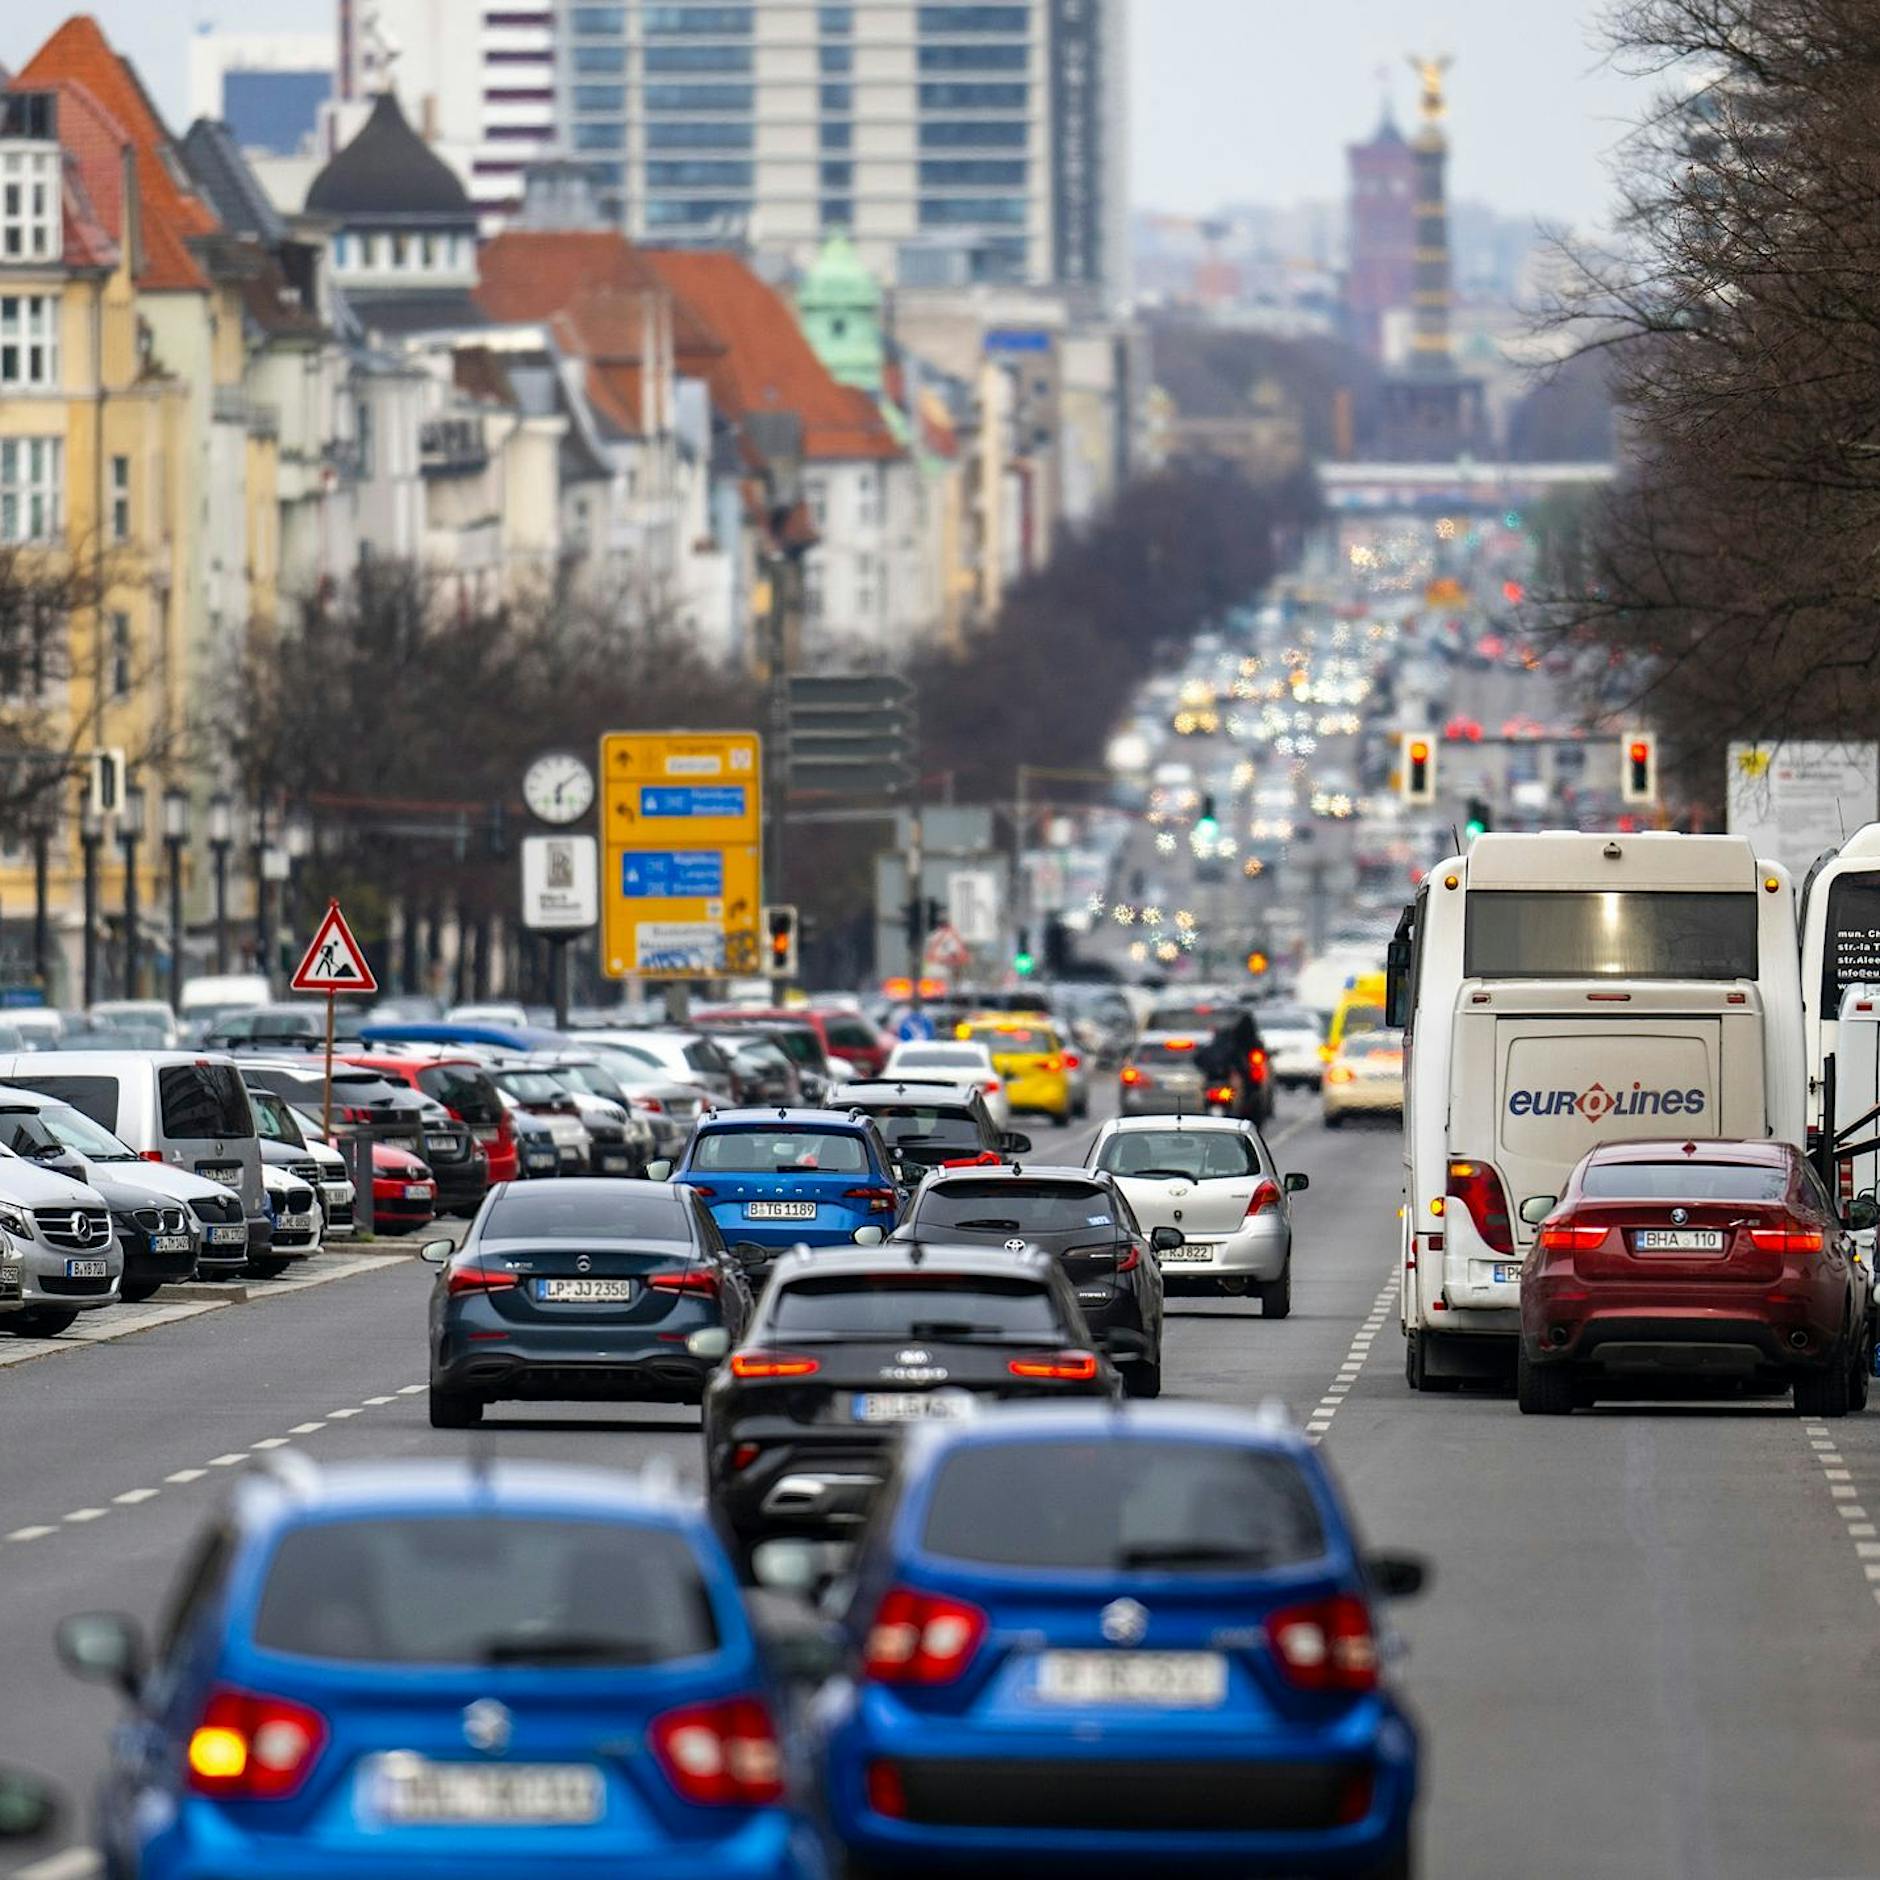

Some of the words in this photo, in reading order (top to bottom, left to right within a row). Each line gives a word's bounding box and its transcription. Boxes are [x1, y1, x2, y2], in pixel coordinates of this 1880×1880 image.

[751, 1204, 758, 1215] B
[766, 1204, 782, 1215] TG
[785, 1204, 814, 1216] 1189
[1646, 1232, 1679, 1246] BHA
[1695, 1232, 1717, 1246] 110
[1170, 1246, 1184, 1257] RJ
[1186, 1246, 1207, 1258] 822
[547, 1281, 565, 1296] LP
[574, 1281, 592, 1296] JJ
[594, 1281, 628, 1296] 2358
